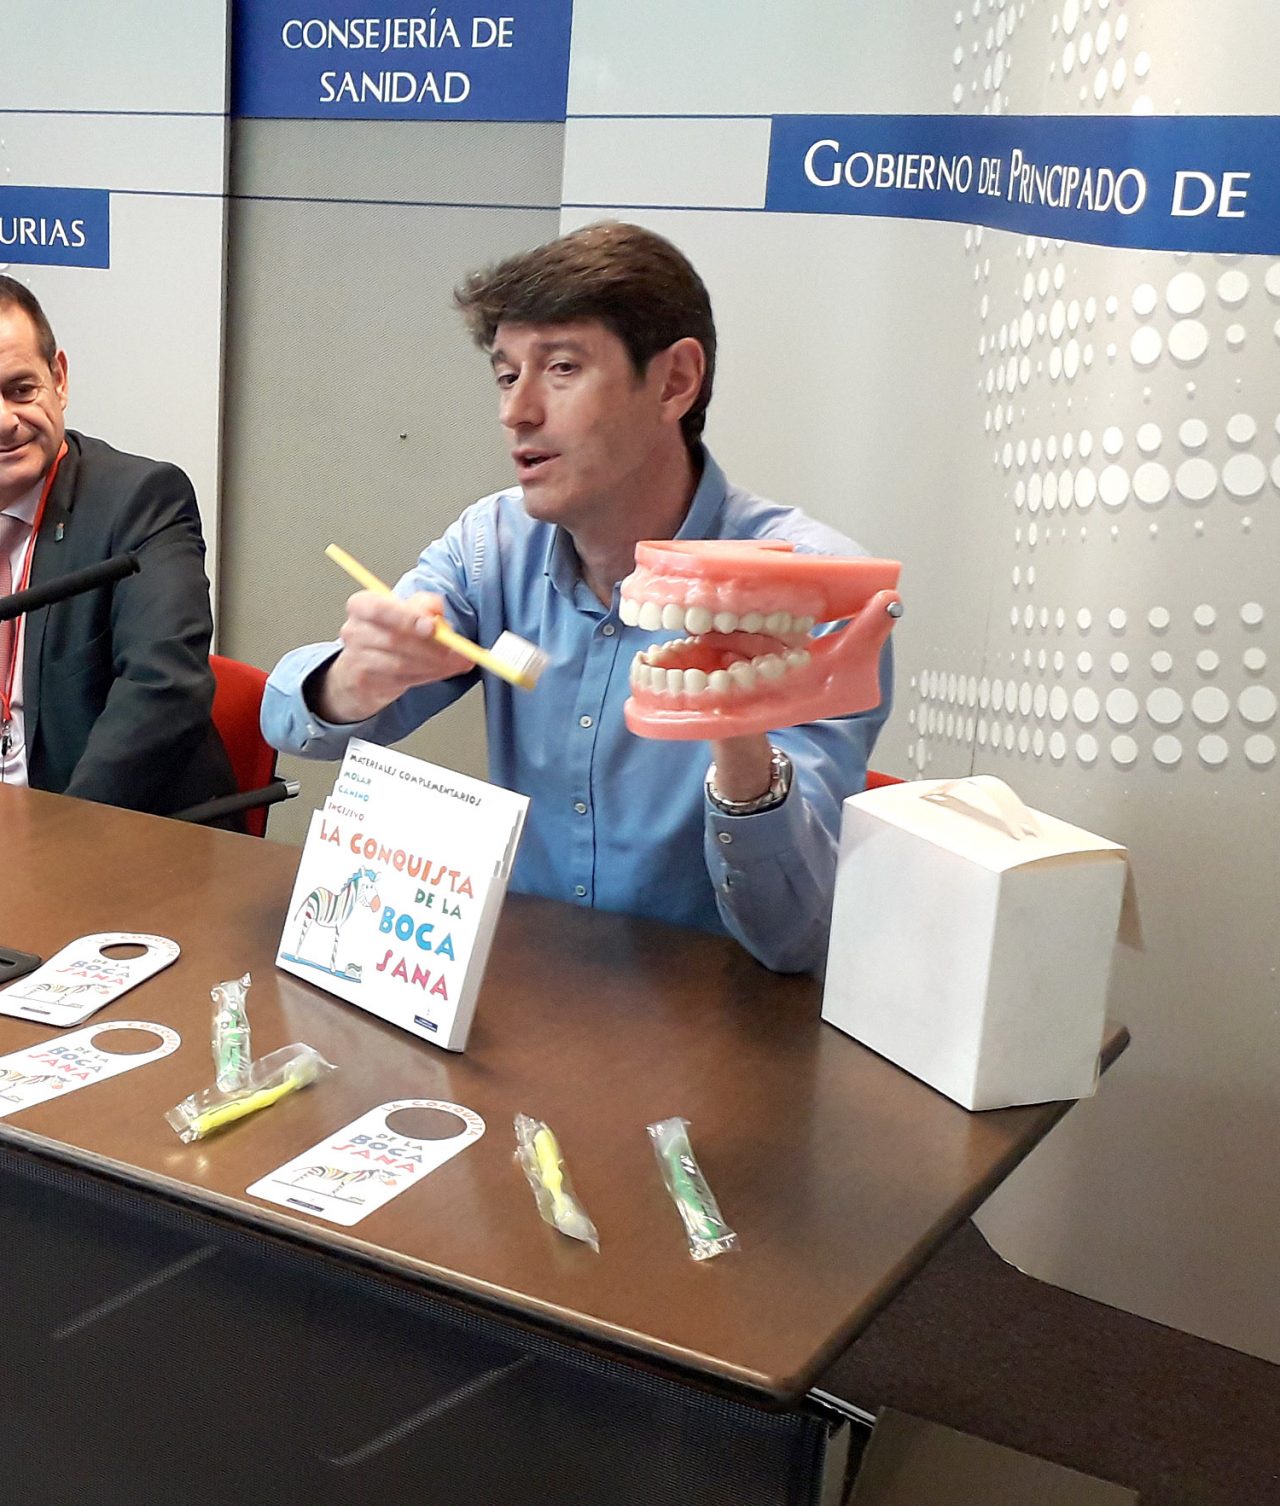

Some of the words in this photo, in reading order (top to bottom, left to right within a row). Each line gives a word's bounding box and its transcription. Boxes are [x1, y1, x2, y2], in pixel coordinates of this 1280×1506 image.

[282, 8, 461, 53] CONSEJERÍA
[471, 17, 514, 48] DE
[319, 71, 471, 103] SANIDAD
[803, 139, 973, 194] GOBIERNO
[977, 156, 1002, 197] DEL
[1008, 149, 1146, 216] PRINCIPADO
[1170, 170, 1252, 219] DE
[349, 753, 397, 777] MATERIALES
[399, 770, 483, 807] COMPLEMENTARIOS
[320, 818, 341, 847] LA
[350, 833, 474, 899] CONQUISTA
[414, 887, 436, 910] DE
[441, 897, 462, 920] LA
[378, 906, 456, 962] BOCA
[56, 968, 124, 986] SANA
[69, 960, 130, 979] BOCA
[376, 949, 449, 1001] SANA
[27, 1053, 91, 1081] SANA
[47, 1046, 103, 1073] BOCA
[381, 1103, 403, 1113] LA
[412, 1100, 483, 1137] CONQUISTA
[349, 1134, 424, 1164] BOCA
[375, 1132, 397, 1143] DE
[404, 1141, 424, 1151] LA
[331, 1143, 416, 1174] SANA
